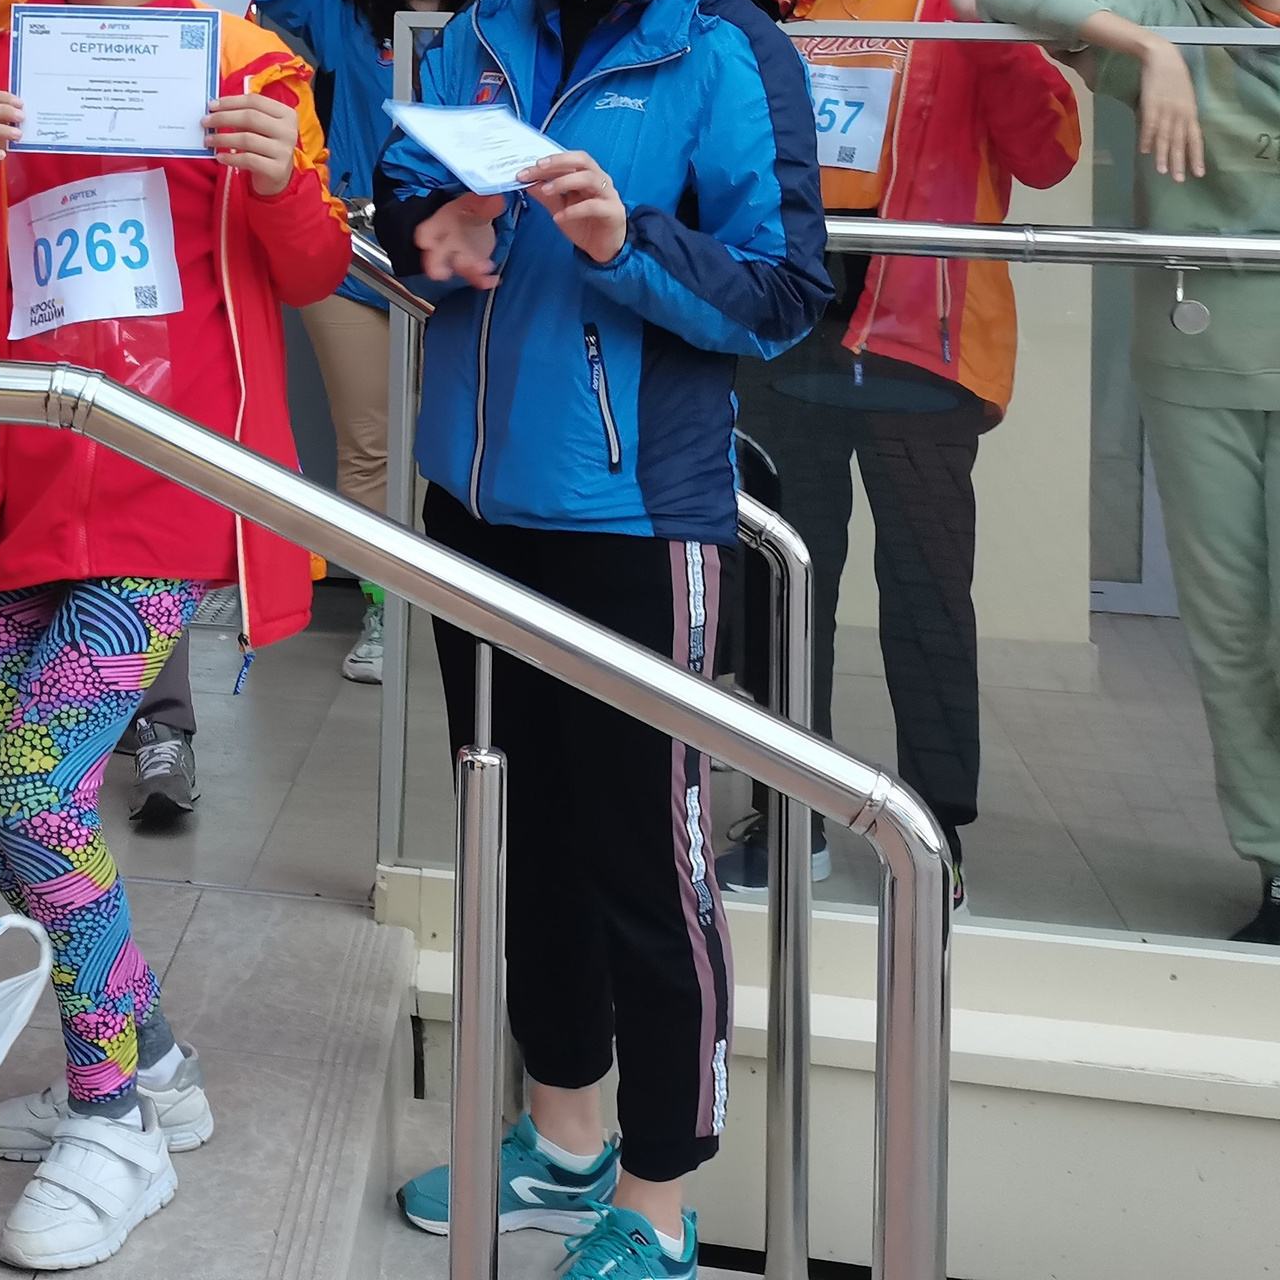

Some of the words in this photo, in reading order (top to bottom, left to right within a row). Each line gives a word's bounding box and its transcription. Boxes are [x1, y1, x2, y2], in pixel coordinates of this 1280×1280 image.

[70, 42, 159, 56] СЕРТИФИКАТ
[812, 97, 865, 134] 57
[69, 189, 97, 201] АРТЕК
[33, 219, 149, 287] 0263
